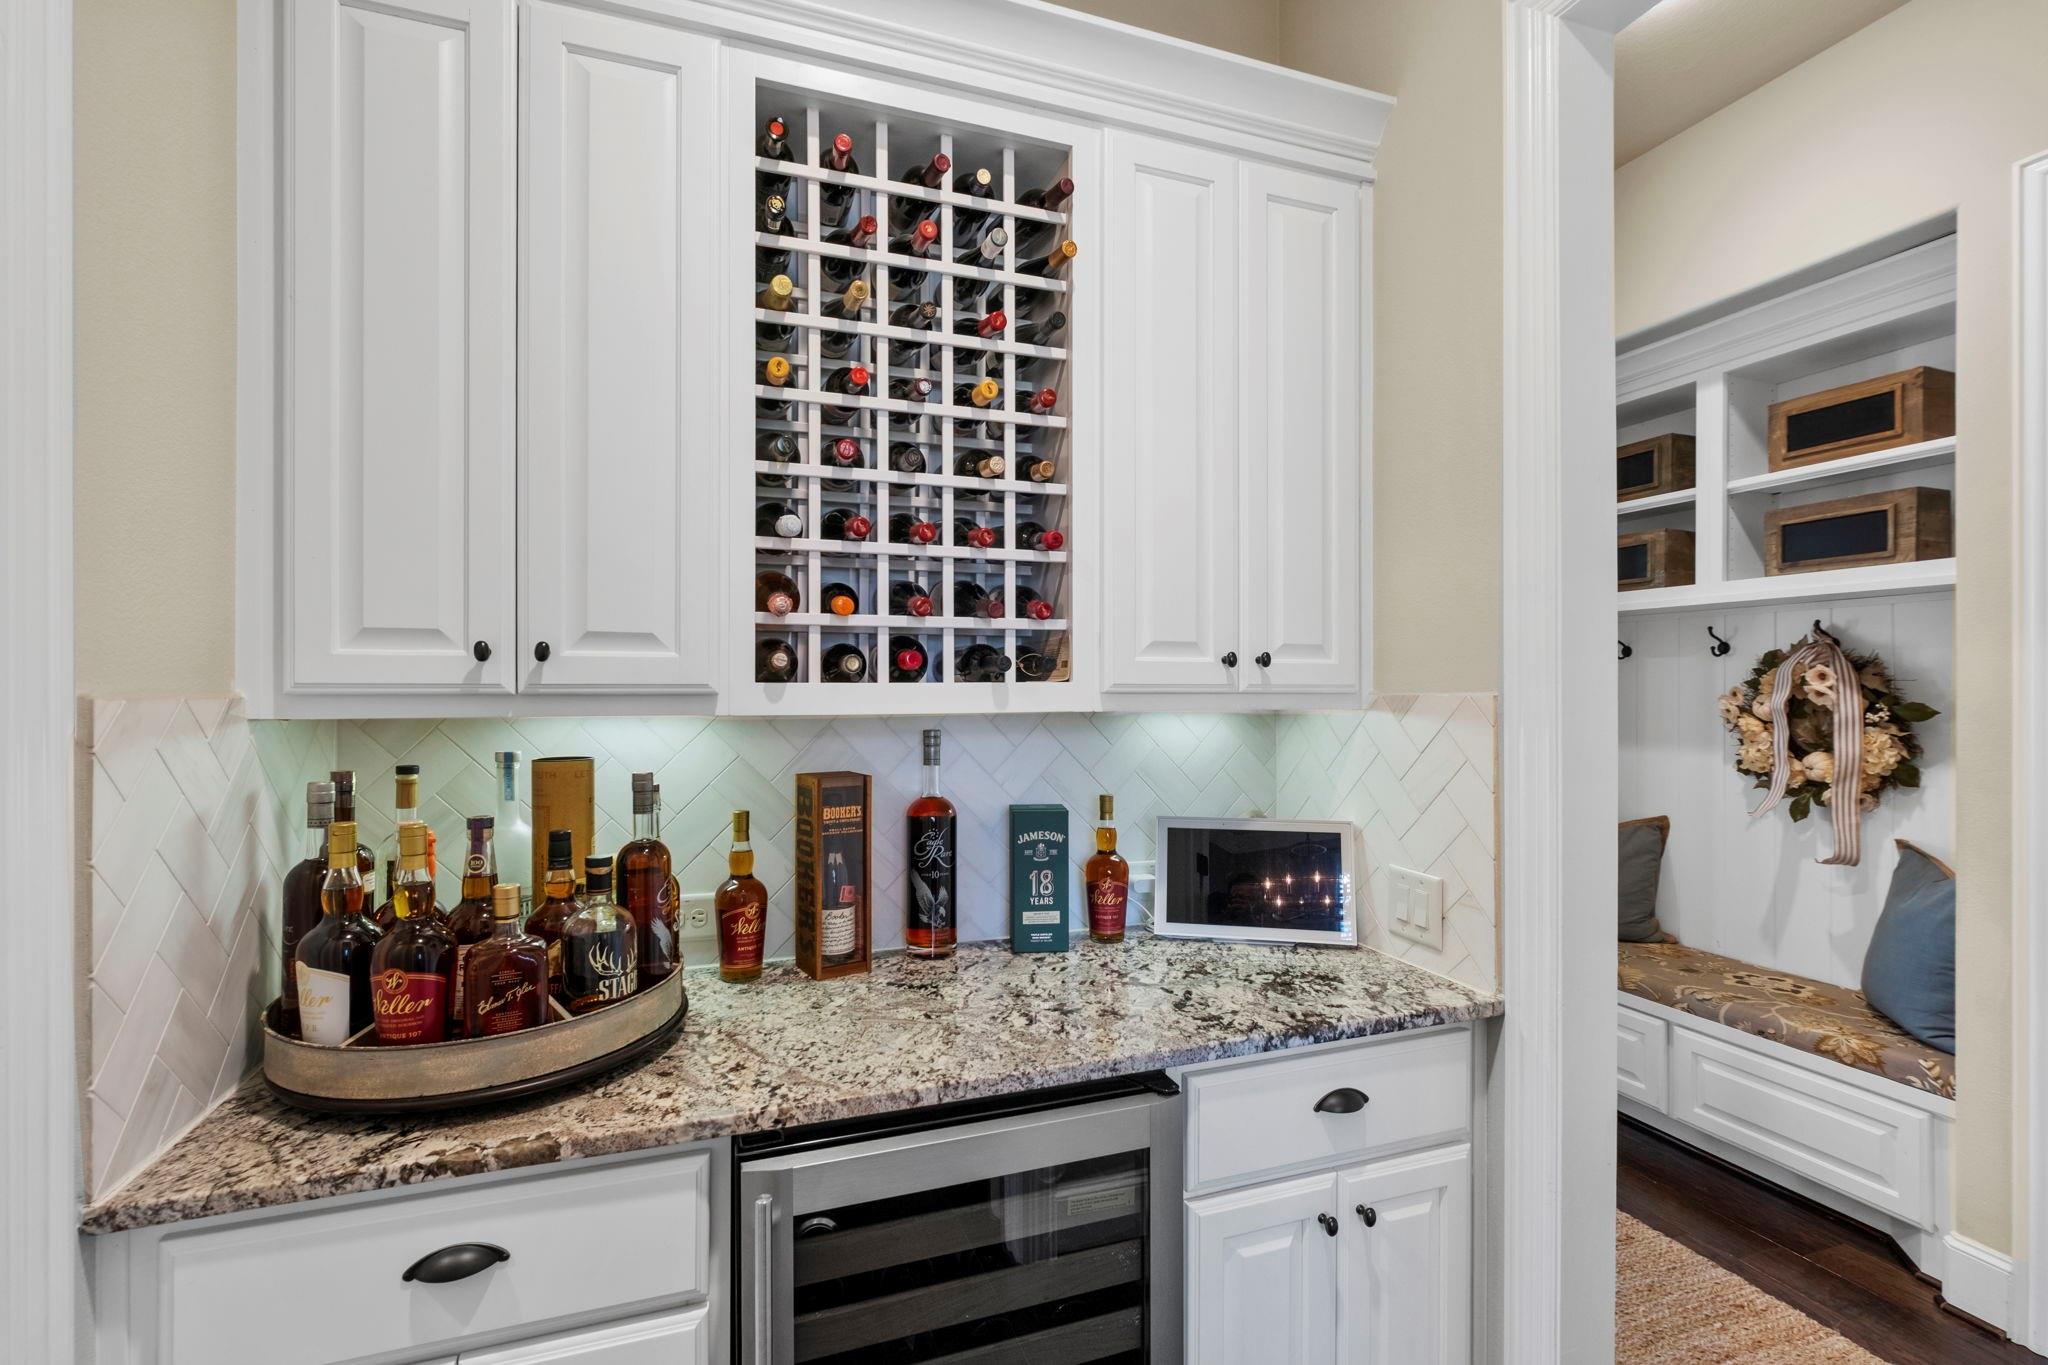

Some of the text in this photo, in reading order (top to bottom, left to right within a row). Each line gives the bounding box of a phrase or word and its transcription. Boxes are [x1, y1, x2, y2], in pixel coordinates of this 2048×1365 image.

[1017, 830, 1064, 844] JAMESON
[1029, 869, 1055, 897] 18
[1030, 897, 1054, 905] YEARS
